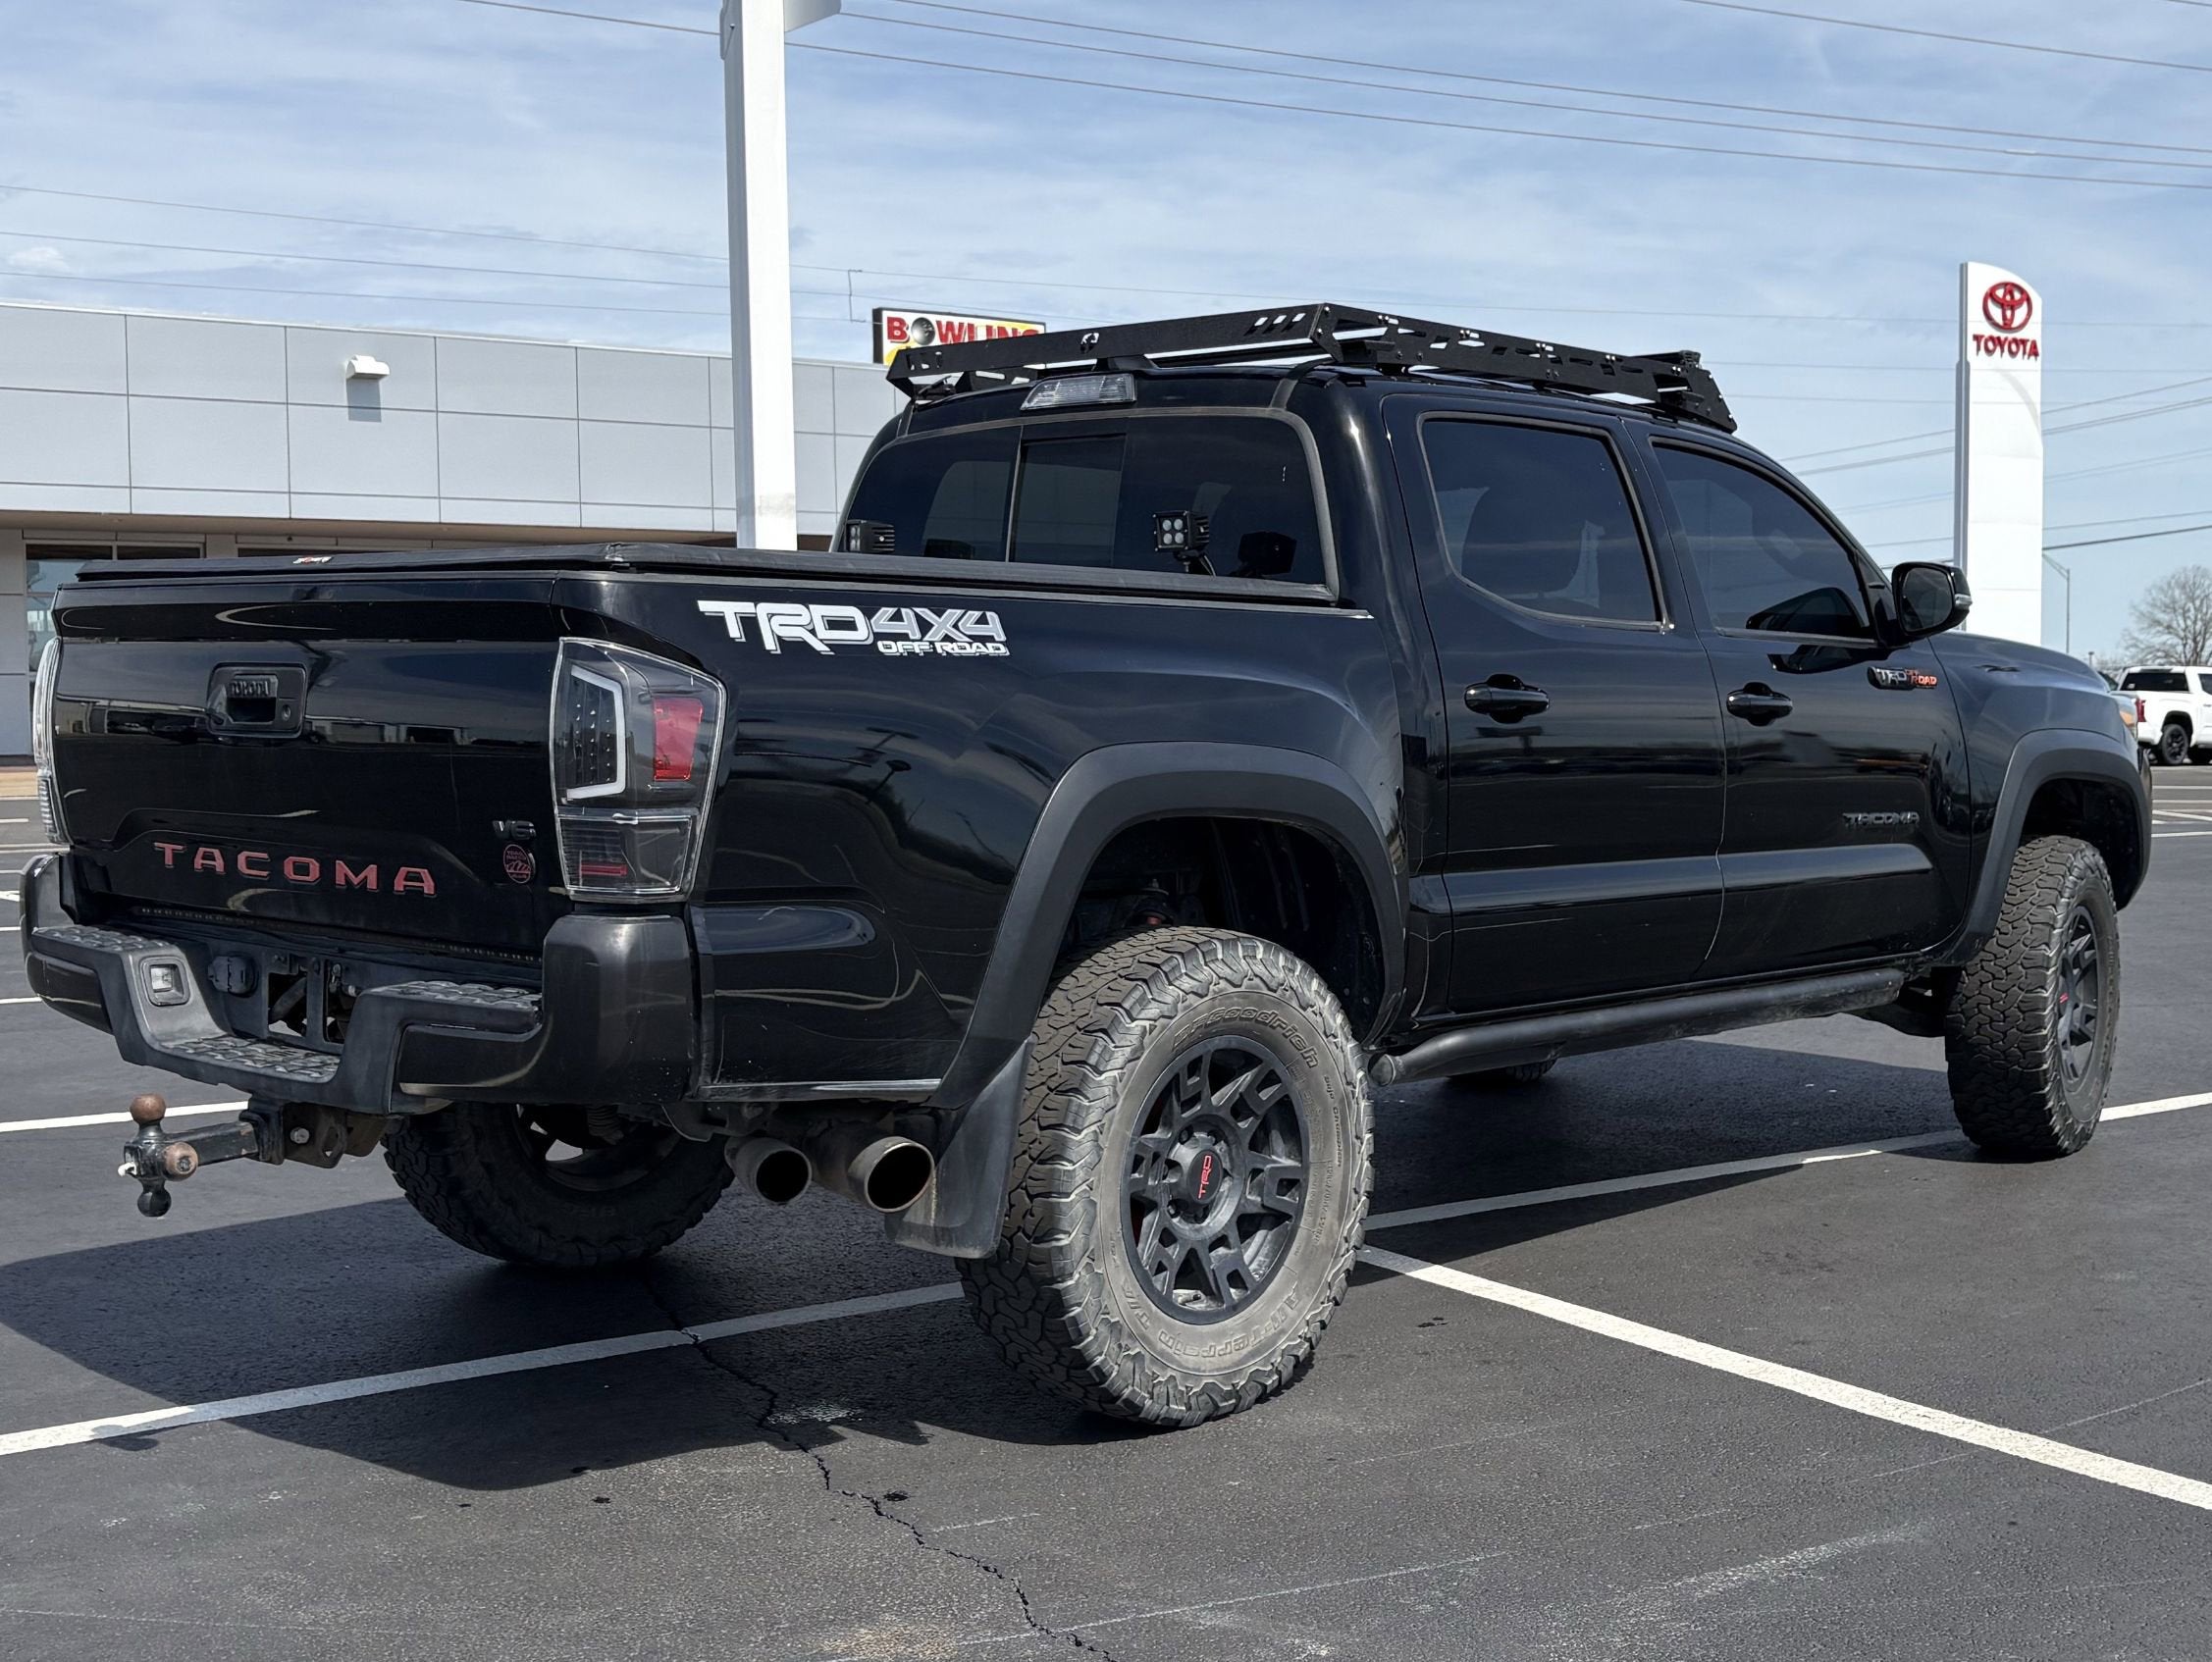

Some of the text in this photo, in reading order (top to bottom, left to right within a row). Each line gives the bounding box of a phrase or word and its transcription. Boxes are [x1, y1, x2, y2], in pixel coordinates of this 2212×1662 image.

[887, 316, 1040, 345] BOWLIN
[1973, 335, 2040, 362] TOYOTA
[697, 599, 872, 655] TRD
[876, 640, 1010, 656] OFF ROAD
[492, 818, 537, 840] V6
[1841, 810, 1921, 827] TACOMA
[152, 841, 437, 899] TACOMA
[1197, 1155, 1212, 1199] TRD
